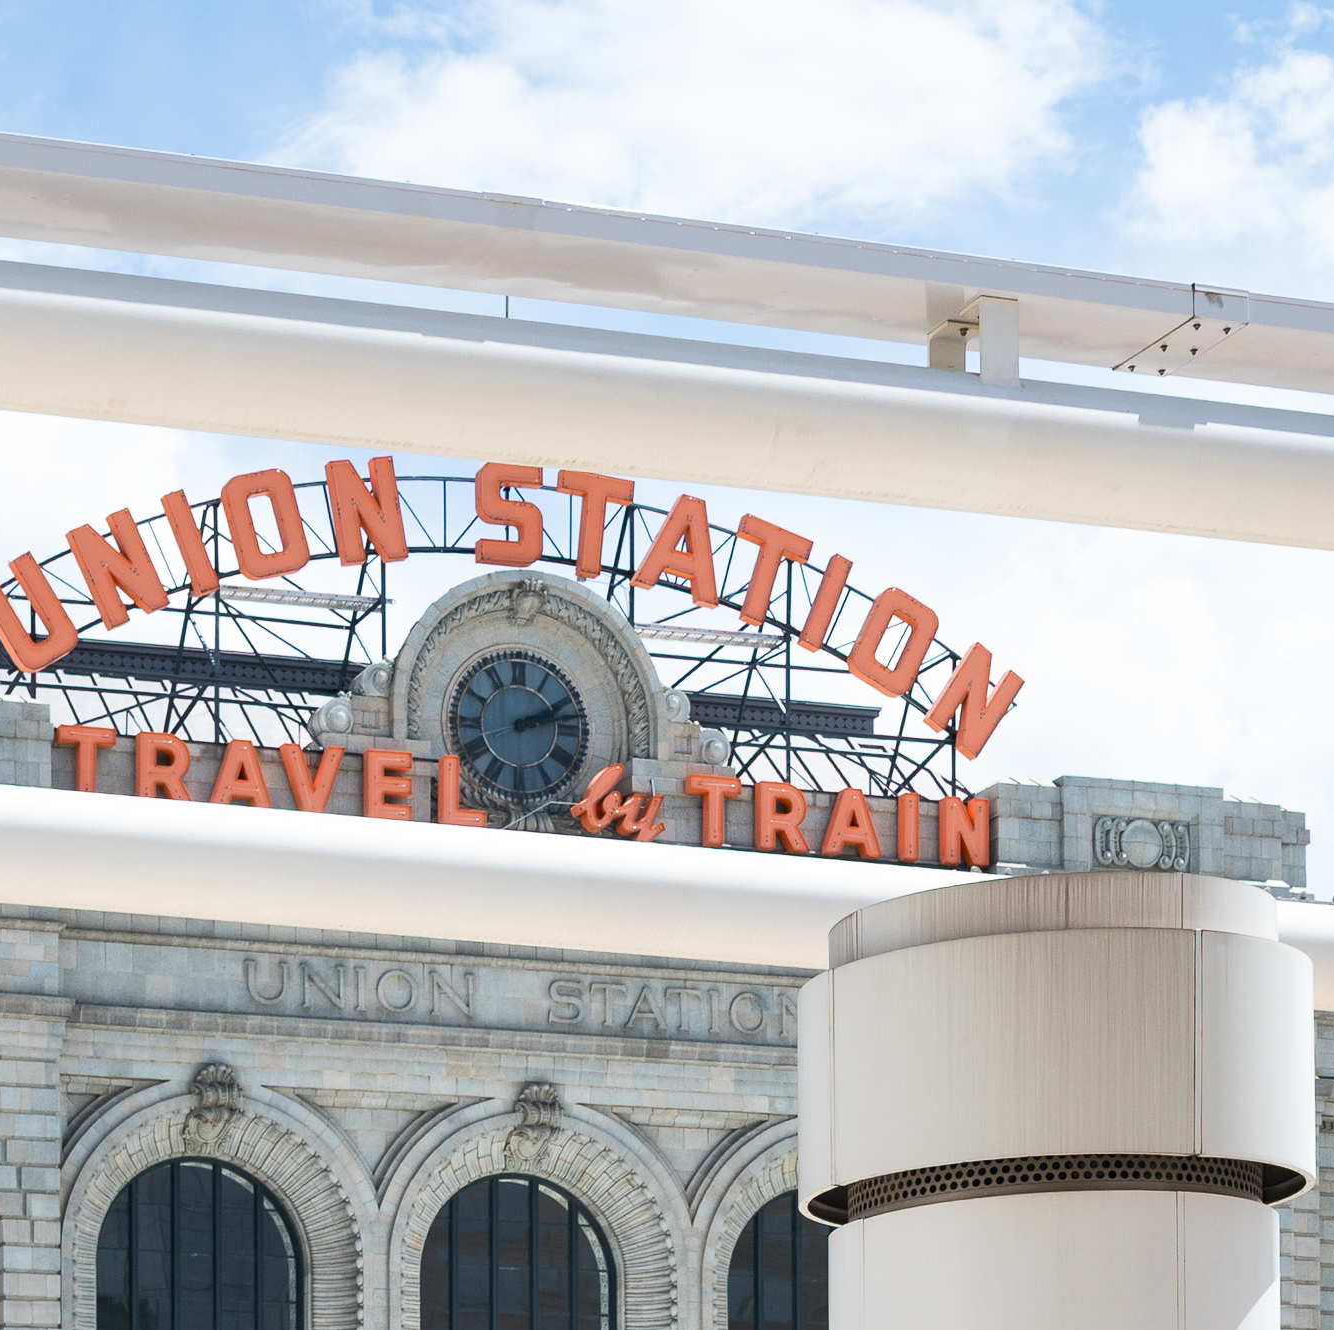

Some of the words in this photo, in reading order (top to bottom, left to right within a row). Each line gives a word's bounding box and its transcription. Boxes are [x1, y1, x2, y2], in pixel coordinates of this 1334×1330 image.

[475, 462, 1025, 760] STATION
[56, 724, 487, 828] TRAVEL
[570, 763, 665, 842] by
[685, 774, 990, 867] TRAIN
[243, 959, 476, 1018] UNION
